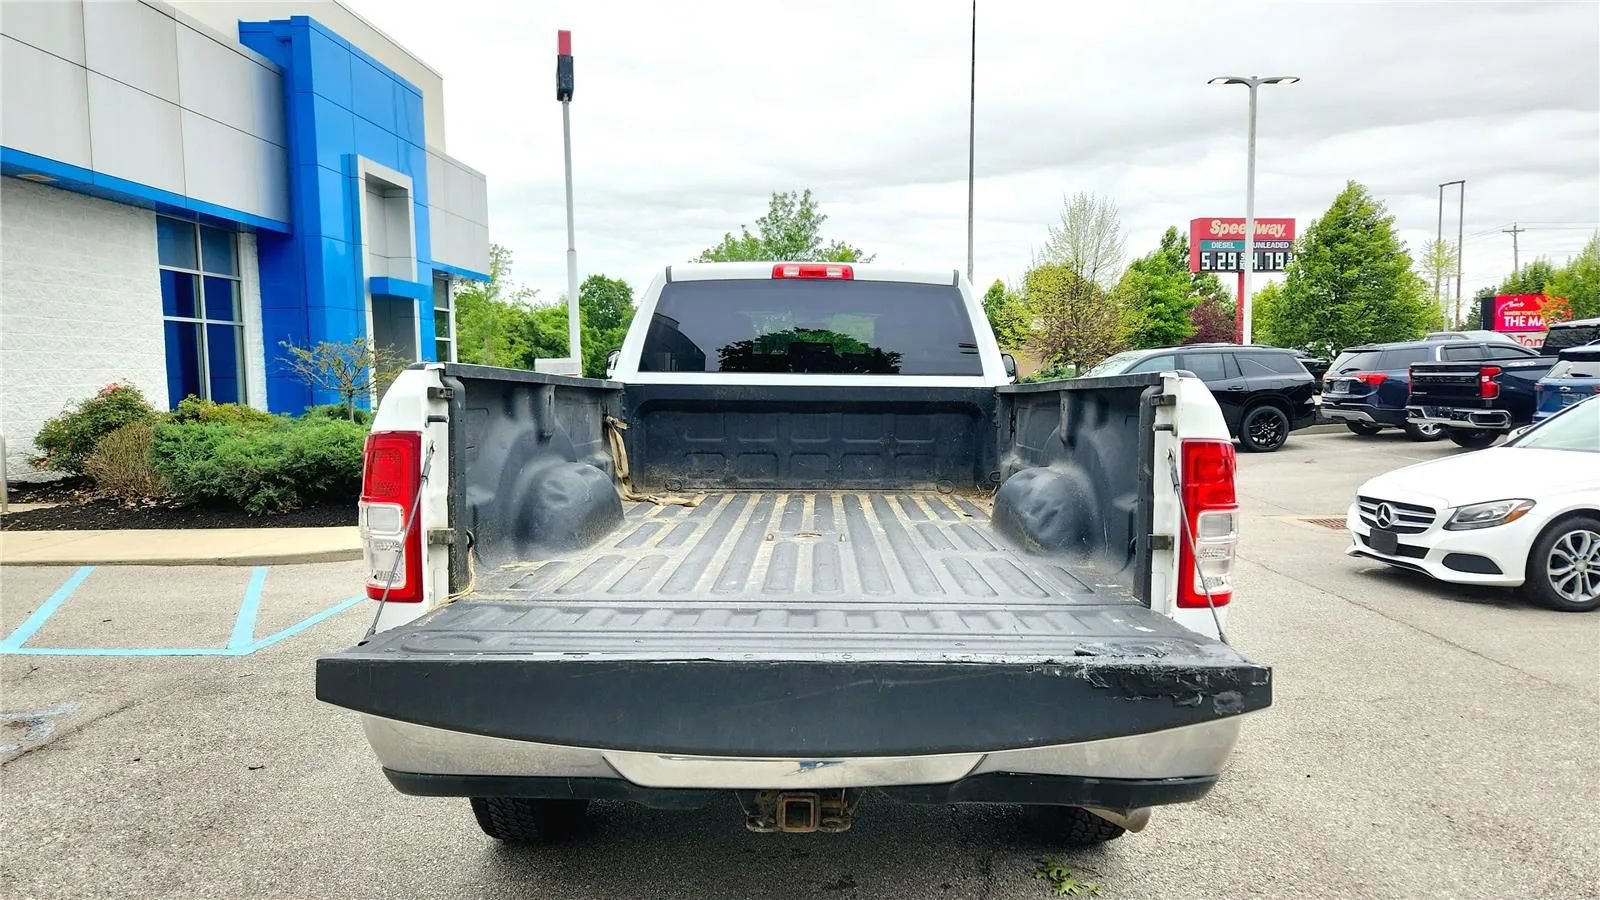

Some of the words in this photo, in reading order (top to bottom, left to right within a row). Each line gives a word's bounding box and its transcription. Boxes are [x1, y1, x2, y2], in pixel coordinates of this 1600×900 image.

[1211, 241, 1236, 249] DIESEL
[1201, 252, 1237, 270] 5.29
[1503, 316, 1527, 327] THE
